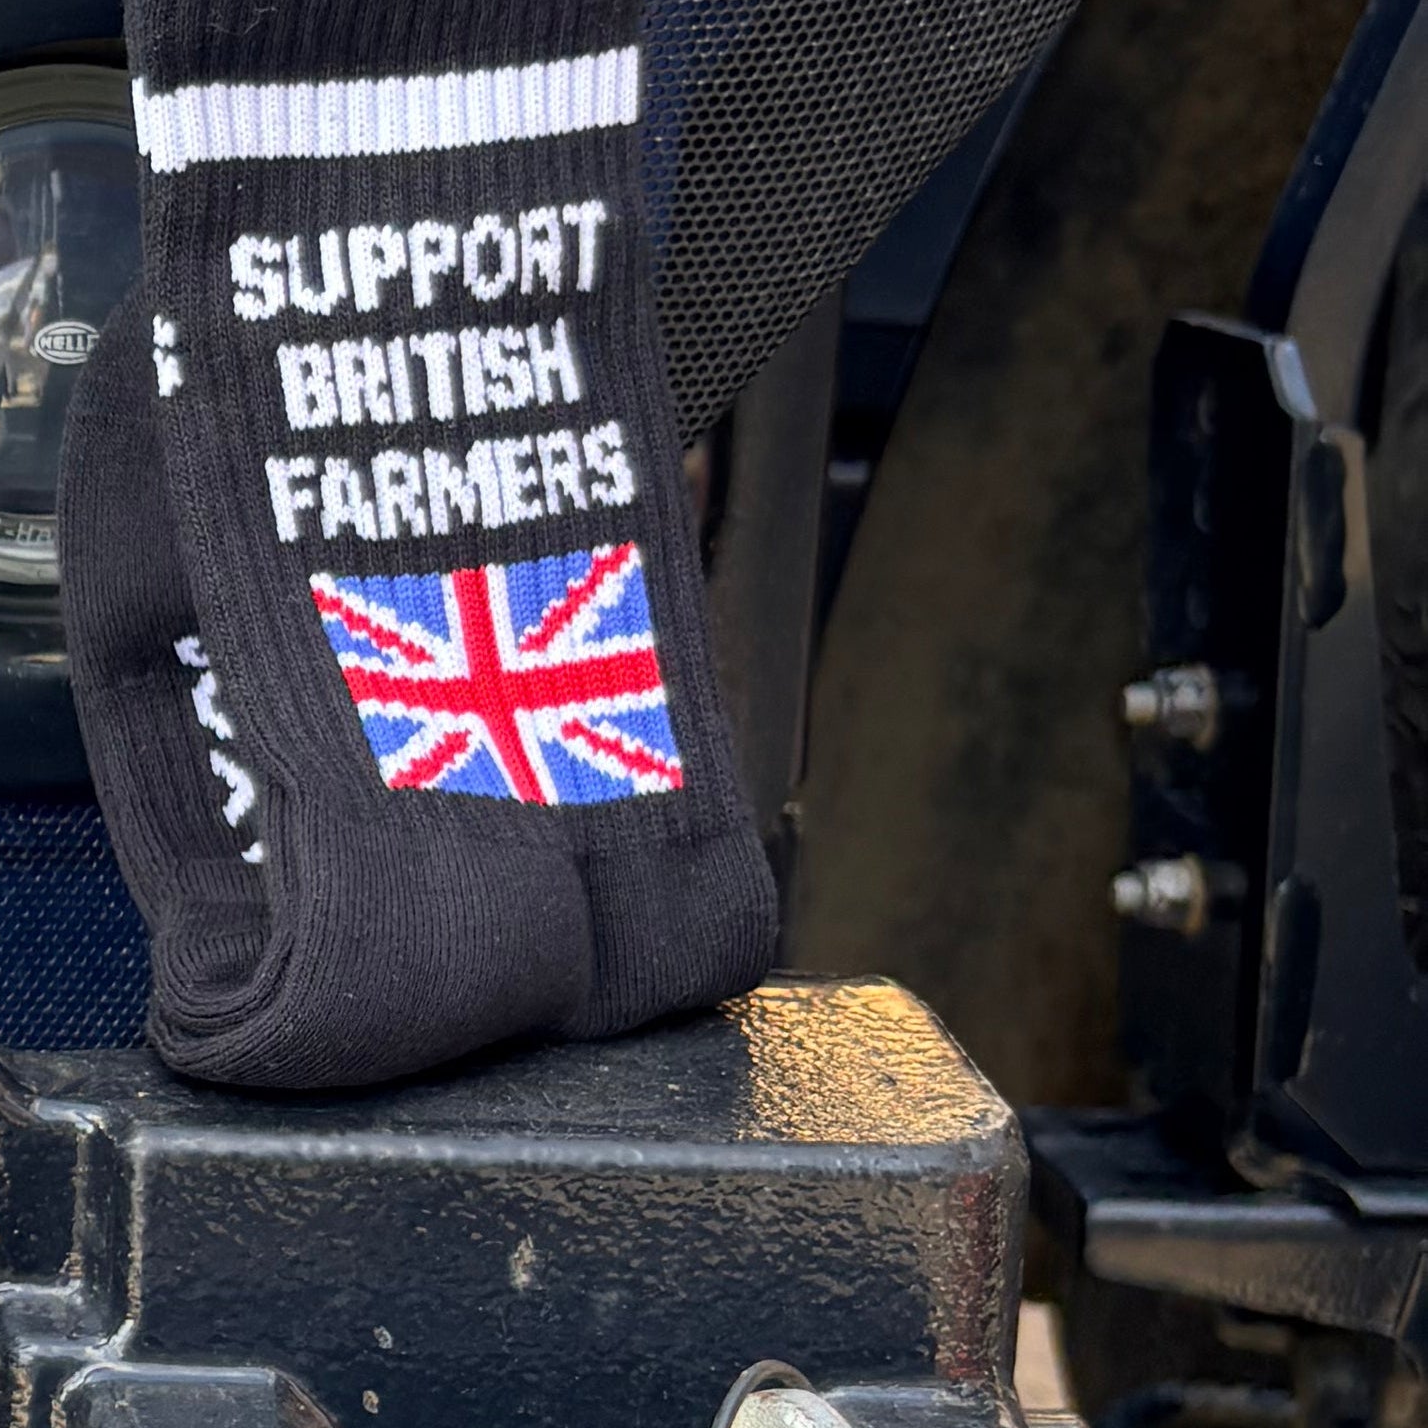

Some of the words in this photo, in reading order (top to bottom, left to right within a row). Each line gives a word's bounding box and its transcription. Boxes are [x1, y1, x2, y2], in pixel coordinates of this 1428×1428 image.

[229, 199, 606, 321] SUPPORT
[277, 316, 580, 430] BRITISH
[264, 420, 635, 543] FARMERS
